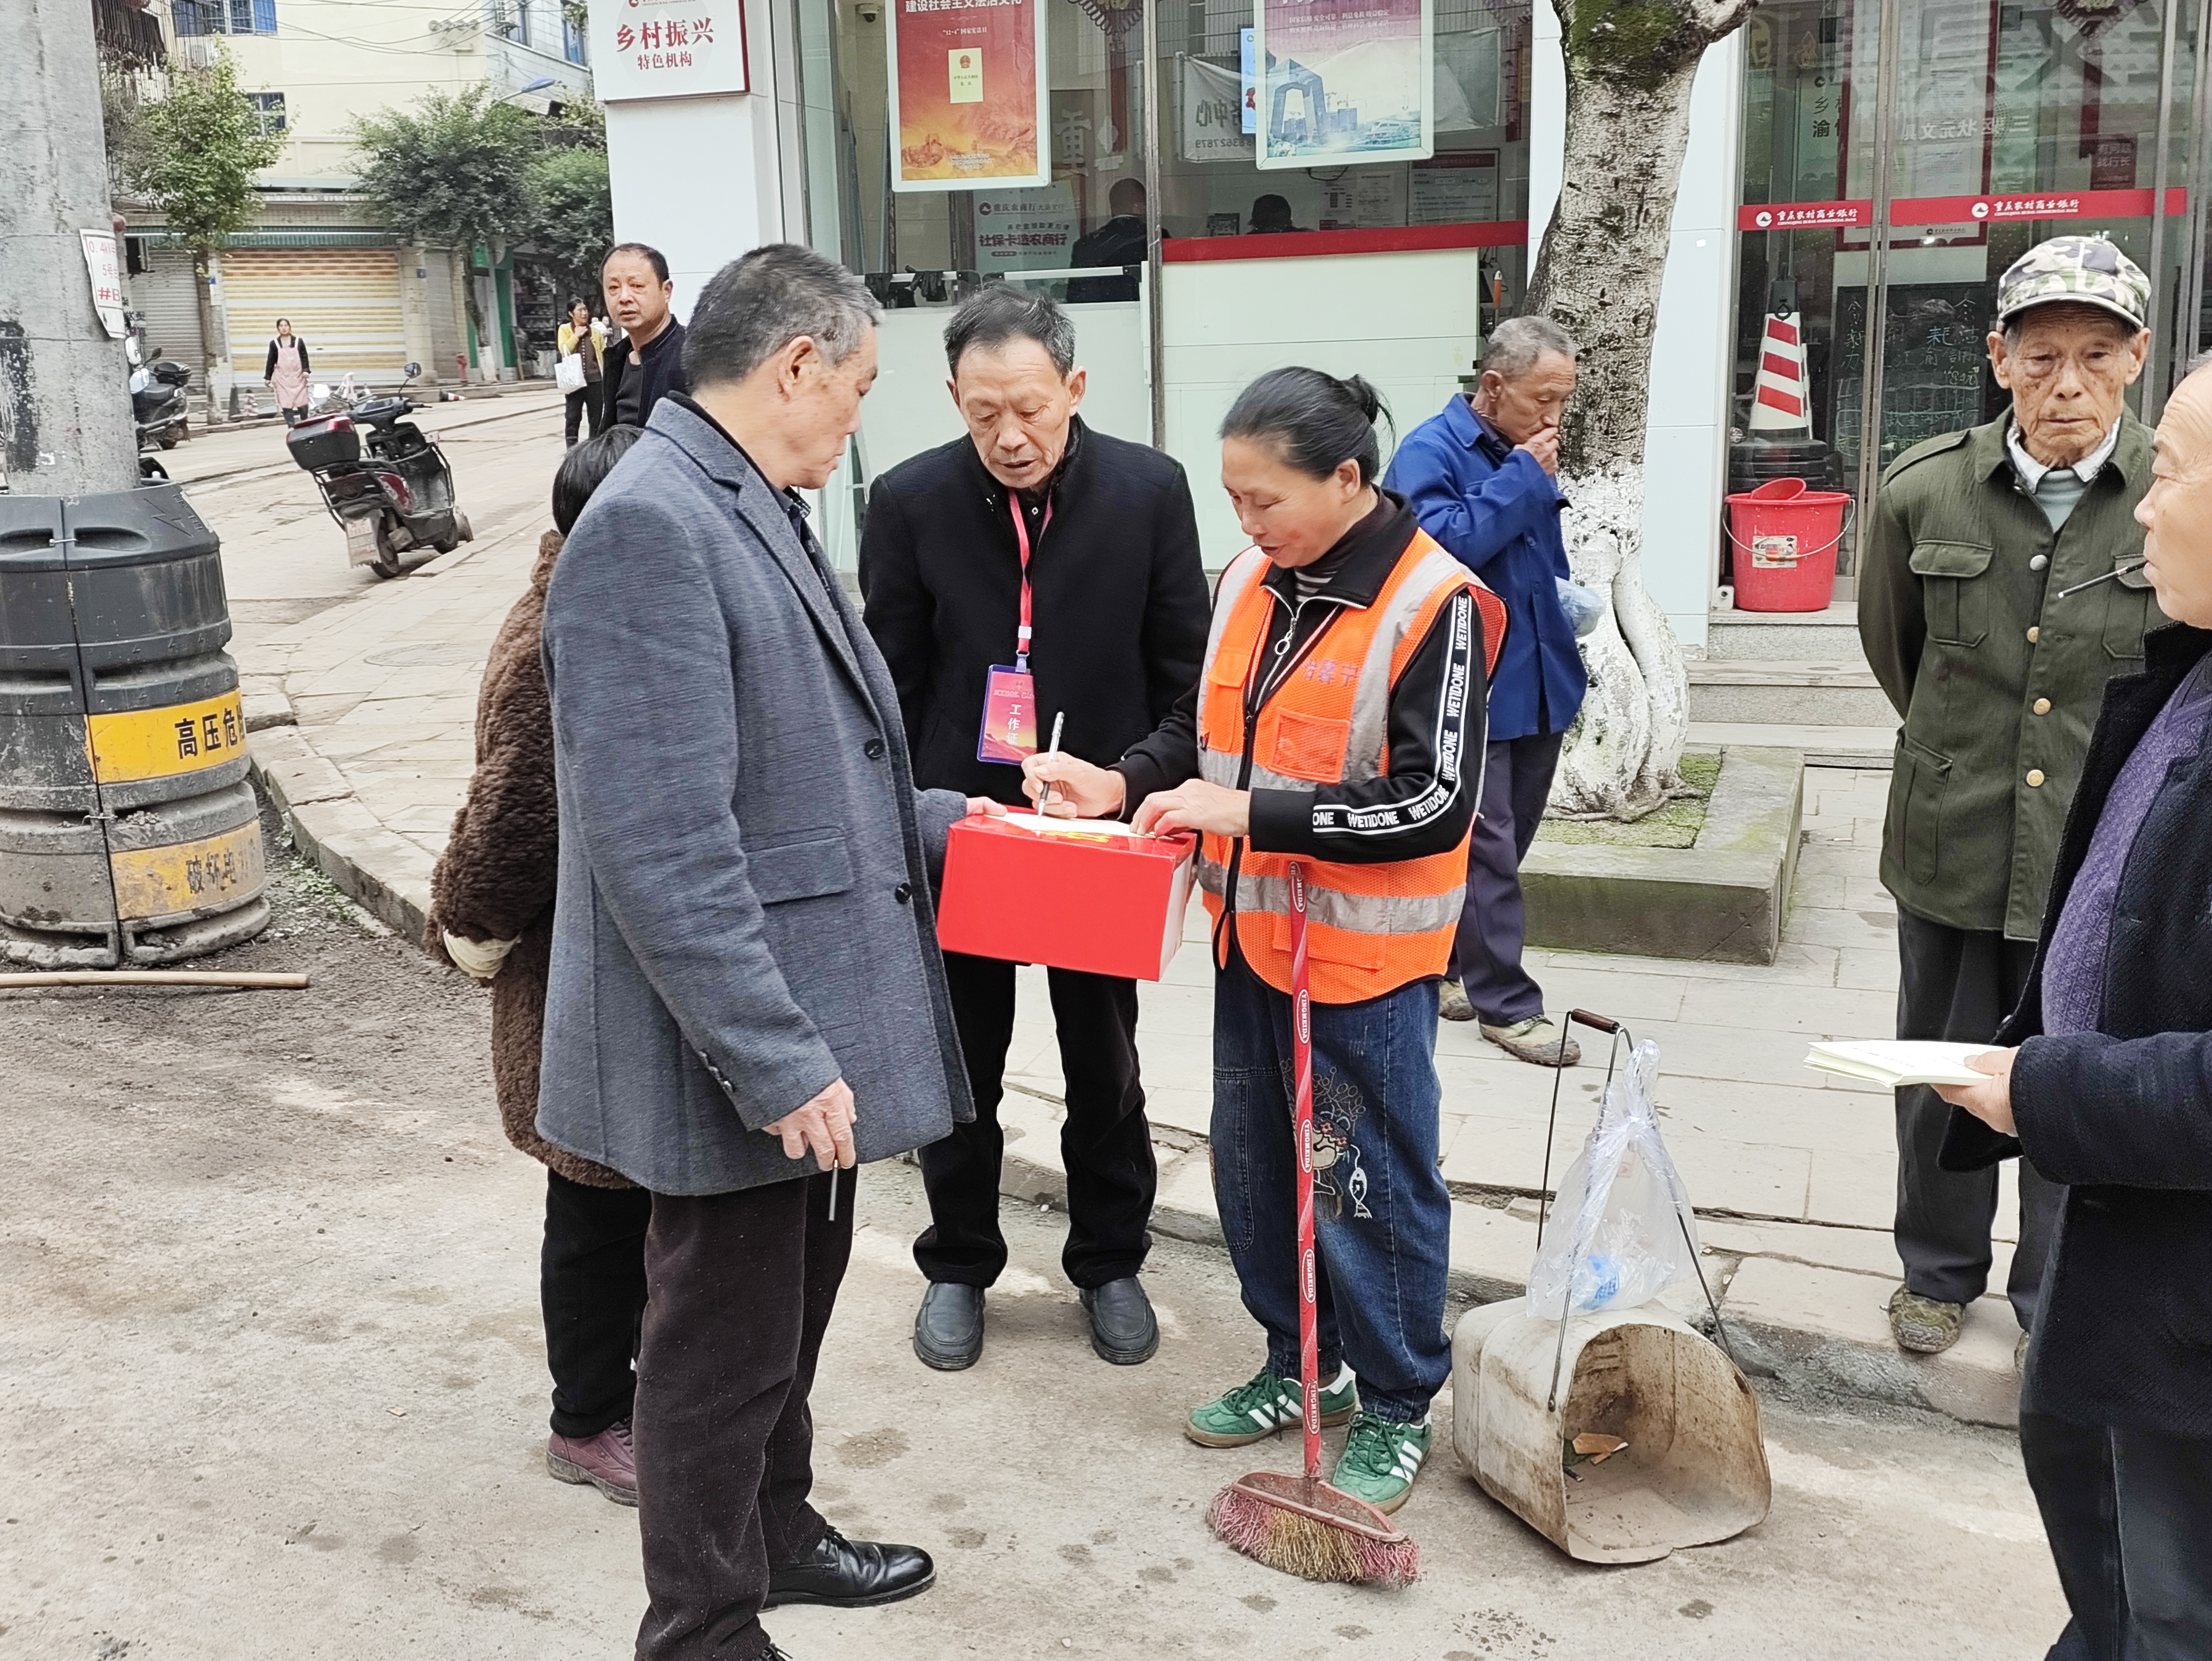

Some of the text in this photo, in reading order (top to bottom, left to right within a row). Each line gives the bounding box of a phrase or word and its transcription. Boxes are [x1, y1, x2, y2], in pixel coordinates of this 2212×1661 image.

[616, 17, 714, 52] 乡村振兴
[637, 51, 692, 70] 特色机构
[1993, 199, 2079, 212] 重庆农村商业银行
[1777, 209, 1858, 221] 重庆农村商业银行
[98, 287, 120, 301] #B
[1006, 703, 1022, 745] 工作证
